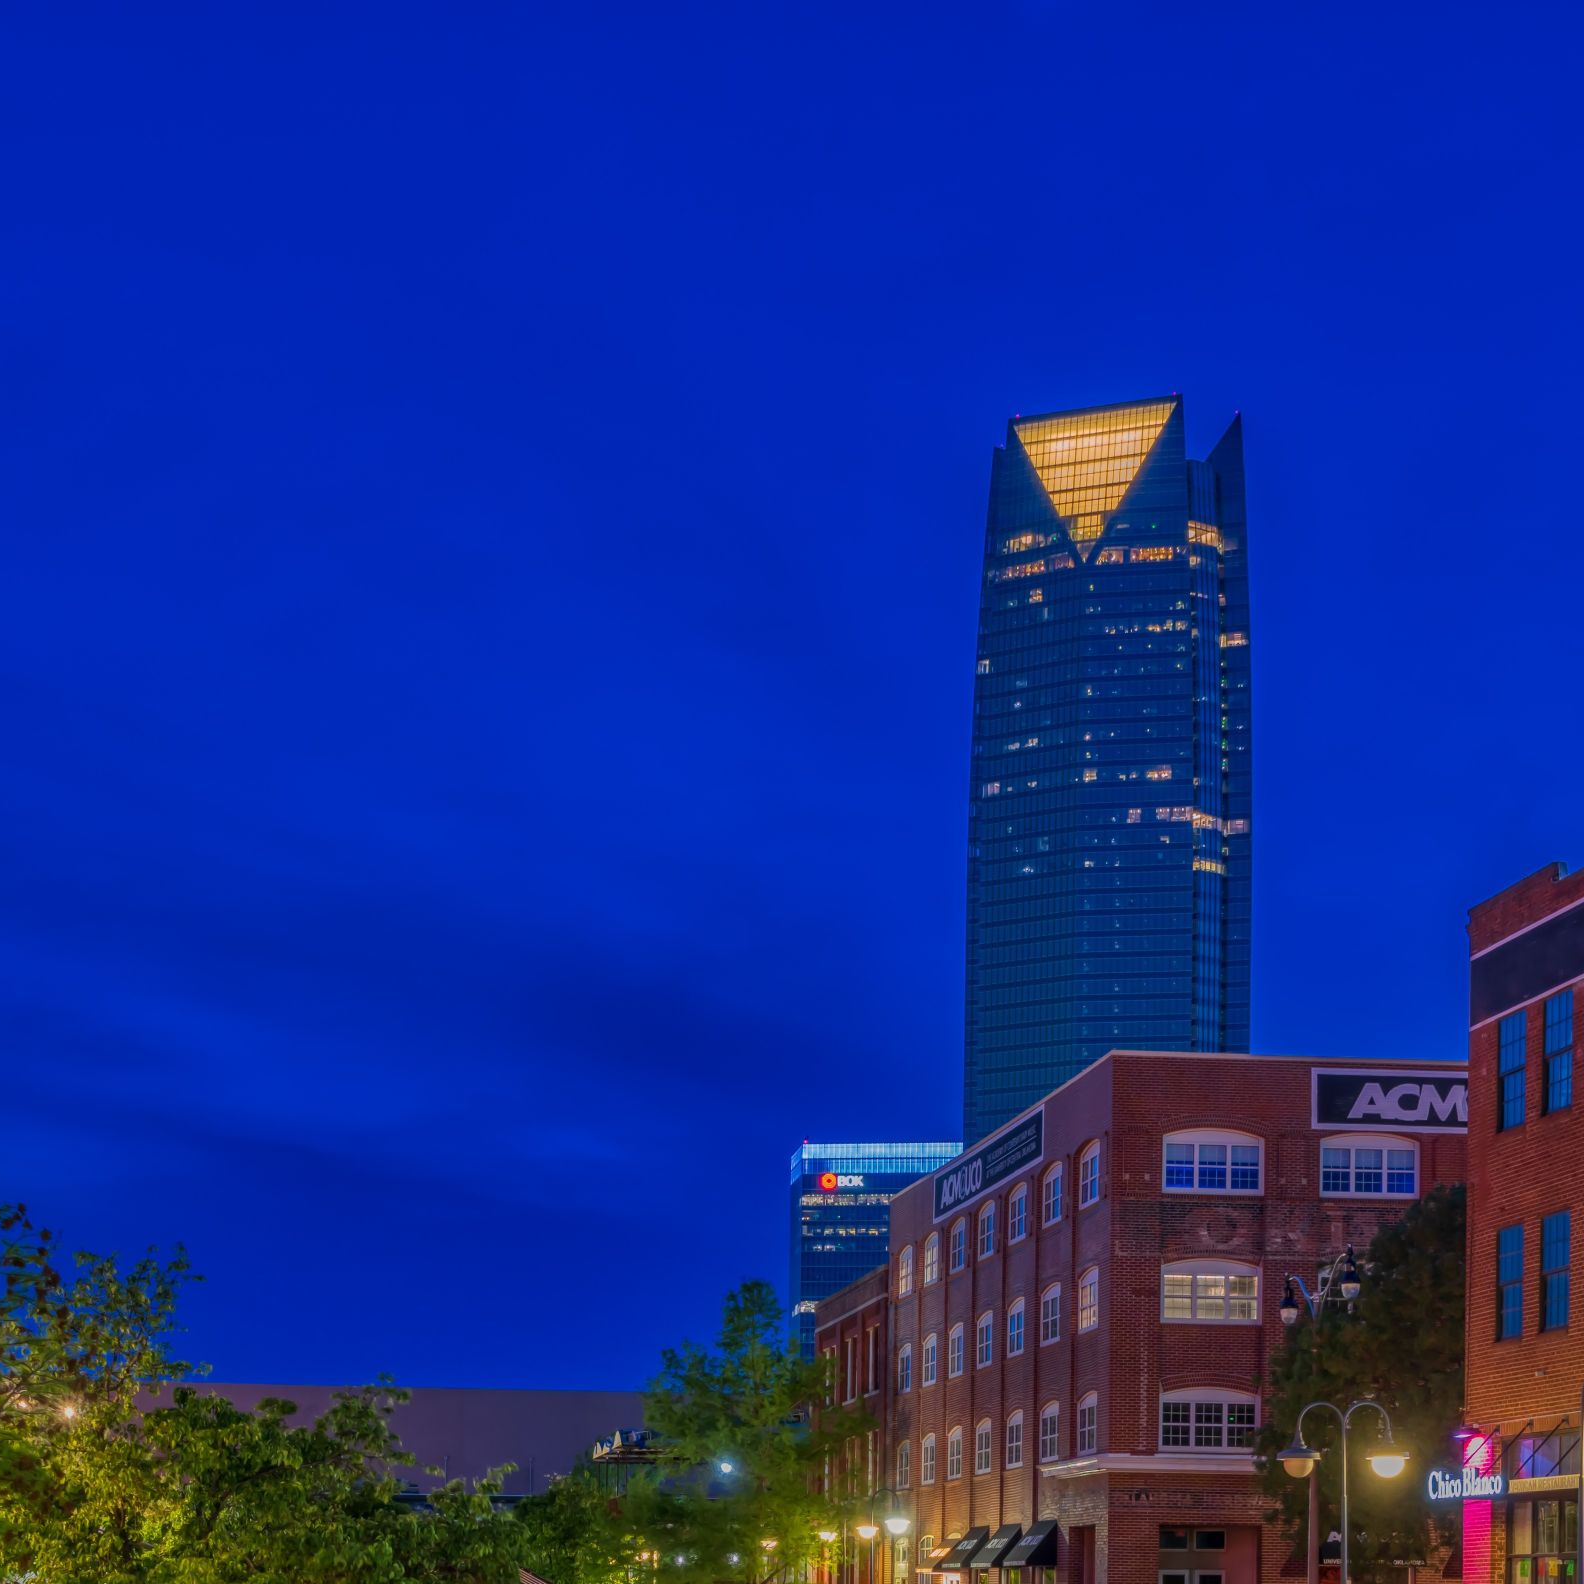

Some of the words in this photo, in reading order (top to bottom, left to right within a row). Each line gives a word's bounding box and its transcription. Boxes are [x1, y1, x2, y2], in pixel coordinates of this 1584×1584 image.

[1347, 1083, 1468, 1122] ACM
[837, 1175, 864, 1187] BOK
[1428, 1470, 1462, 1500] Chico
[1462, 1467, 1502, 1497] Blanco
